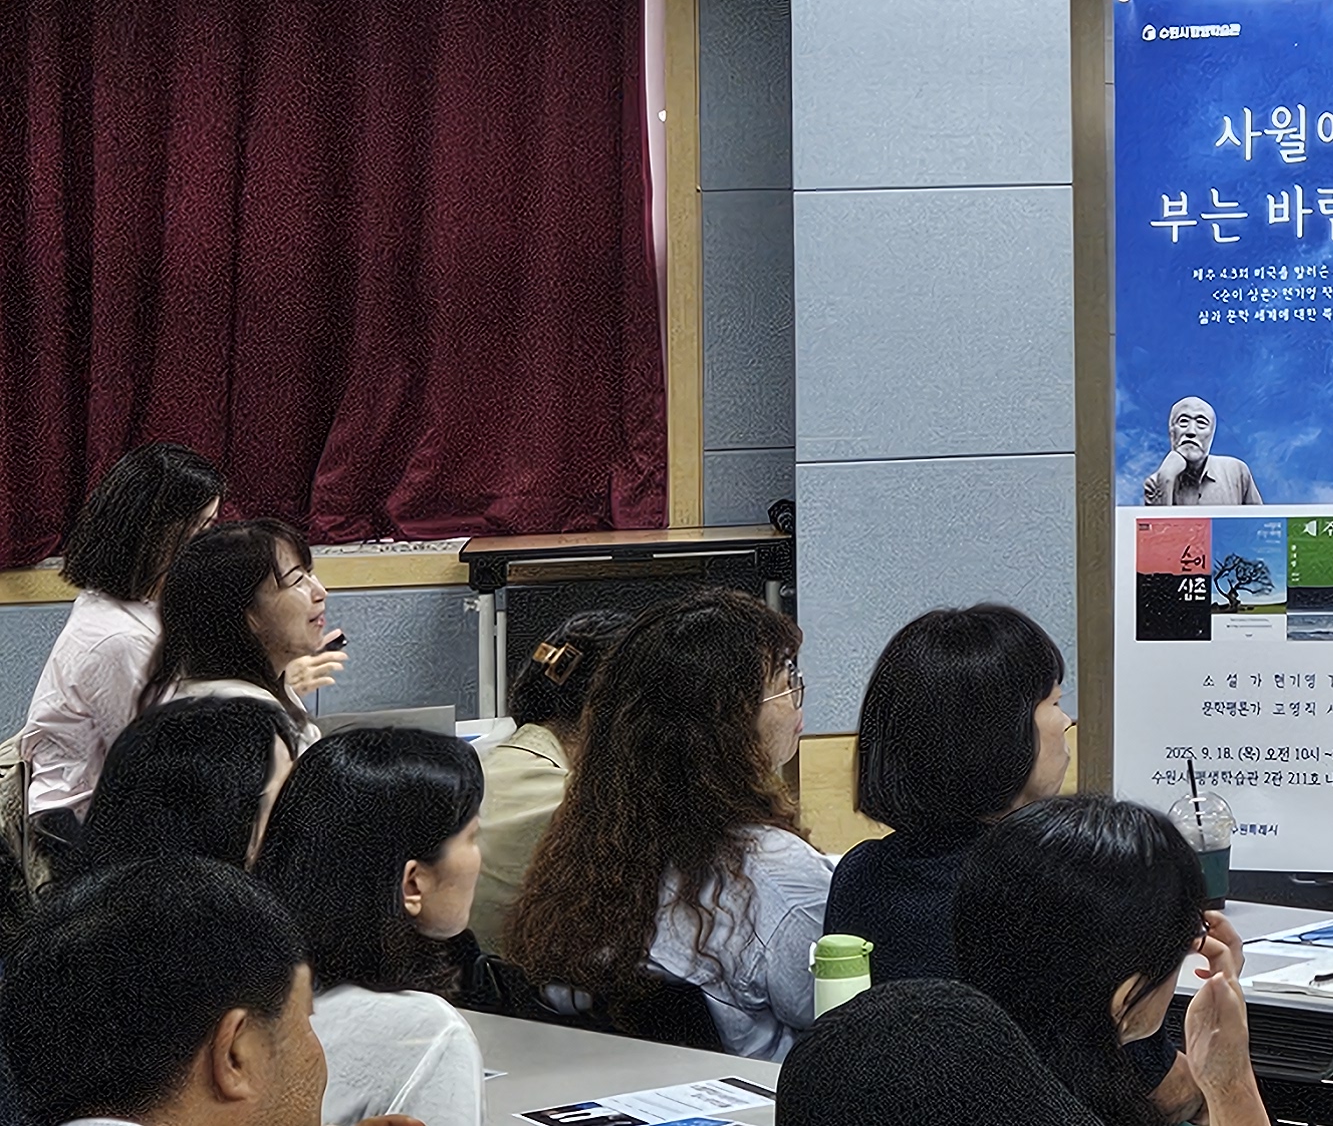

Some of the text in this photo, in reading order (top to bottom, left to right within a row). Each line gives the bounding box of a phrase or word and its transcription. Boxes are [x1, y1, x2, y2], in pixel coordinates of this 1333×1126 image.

[1150, 188, 1249, 244] 부는
[1180, 545, 1206, 572] 순이
[1201, 746, 1213, 760] 9.
[1217, 747, 1234, 760] 18.
[1238, 746, 1261, 763] (목)
[1265, 746, 1290, 763] 오전
[1295, 746, 1320, 762] 10시
[1263, 771, 1283, 786] 2관
[1287, 771, 1321, 786] 211호
